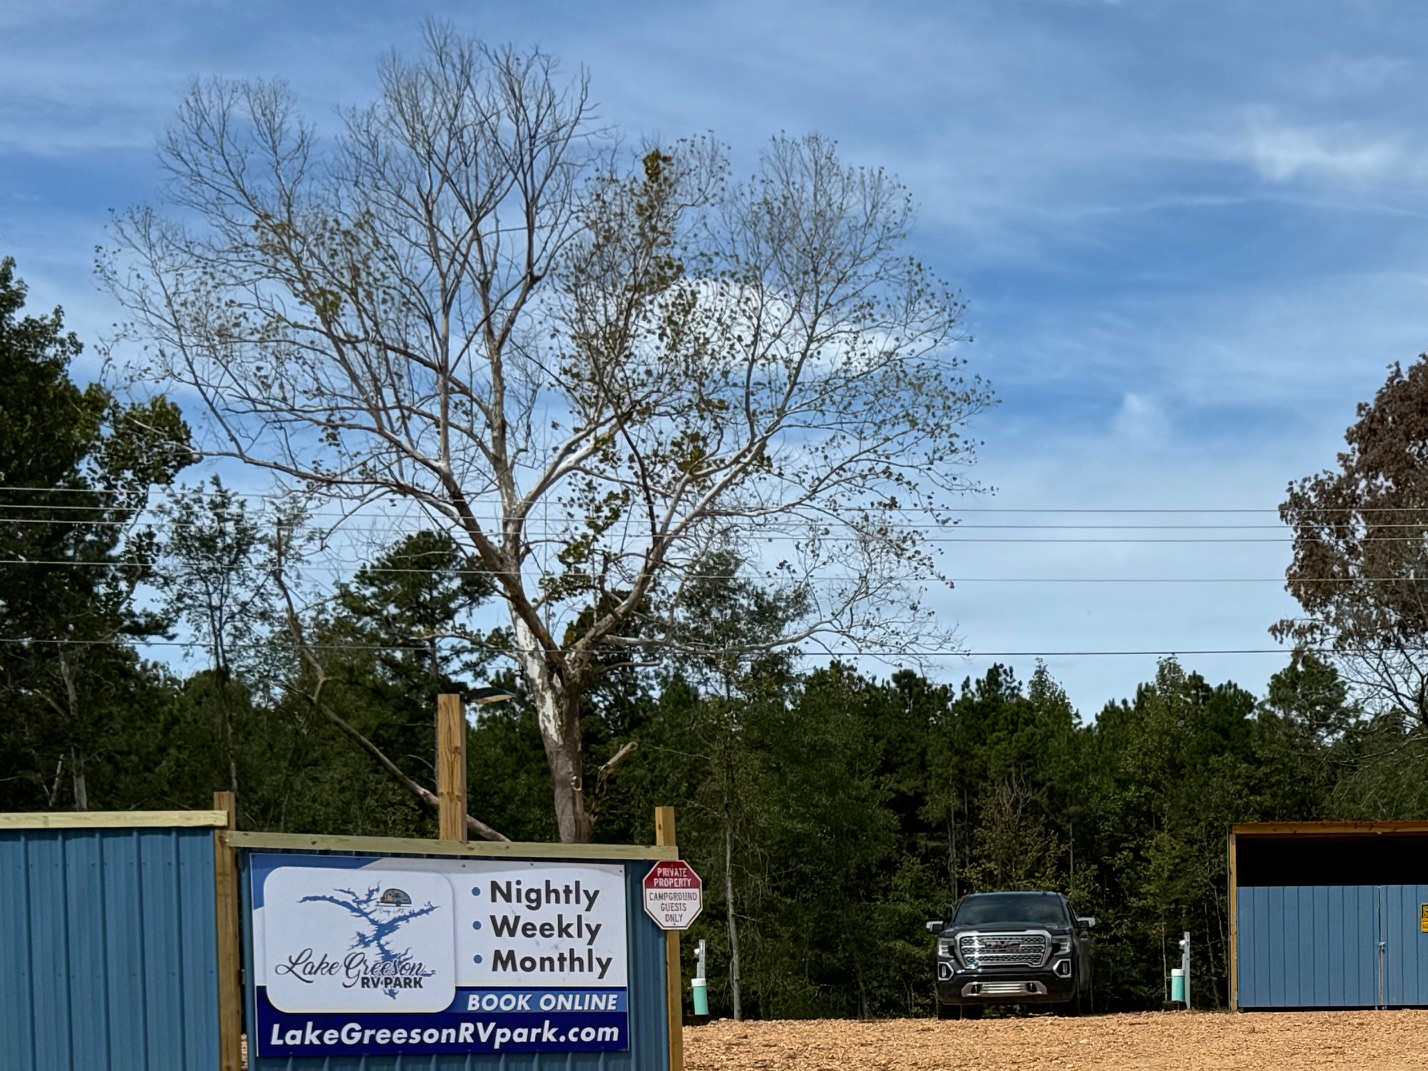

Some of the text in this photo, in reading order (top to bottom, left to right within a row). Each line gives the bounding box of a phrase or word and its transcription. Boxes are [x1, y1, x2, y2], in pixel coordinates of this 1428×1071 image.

[657, 867, 687, 877] PRIVATE
[653, 878, 692, 887] PROPERTY
[490, 879, 600, 912] Nightly
[649, 892, 697, 901] CAMPGROUND
[660, 902, 687, 912] GUESTS
[664, 913, 683, 922] ONLY
[489, 914, 602, 945] Weekly
[275, 947, 427, 988] Lake Greeson
[491, 948, 613, 979] Monthly
[361, 976, 424, 989] RV PARK
[467, 993, 618, 1011] BOOK ONLINE
[270, 1020, 620, 1049] LakeGreesonRVpark.com
